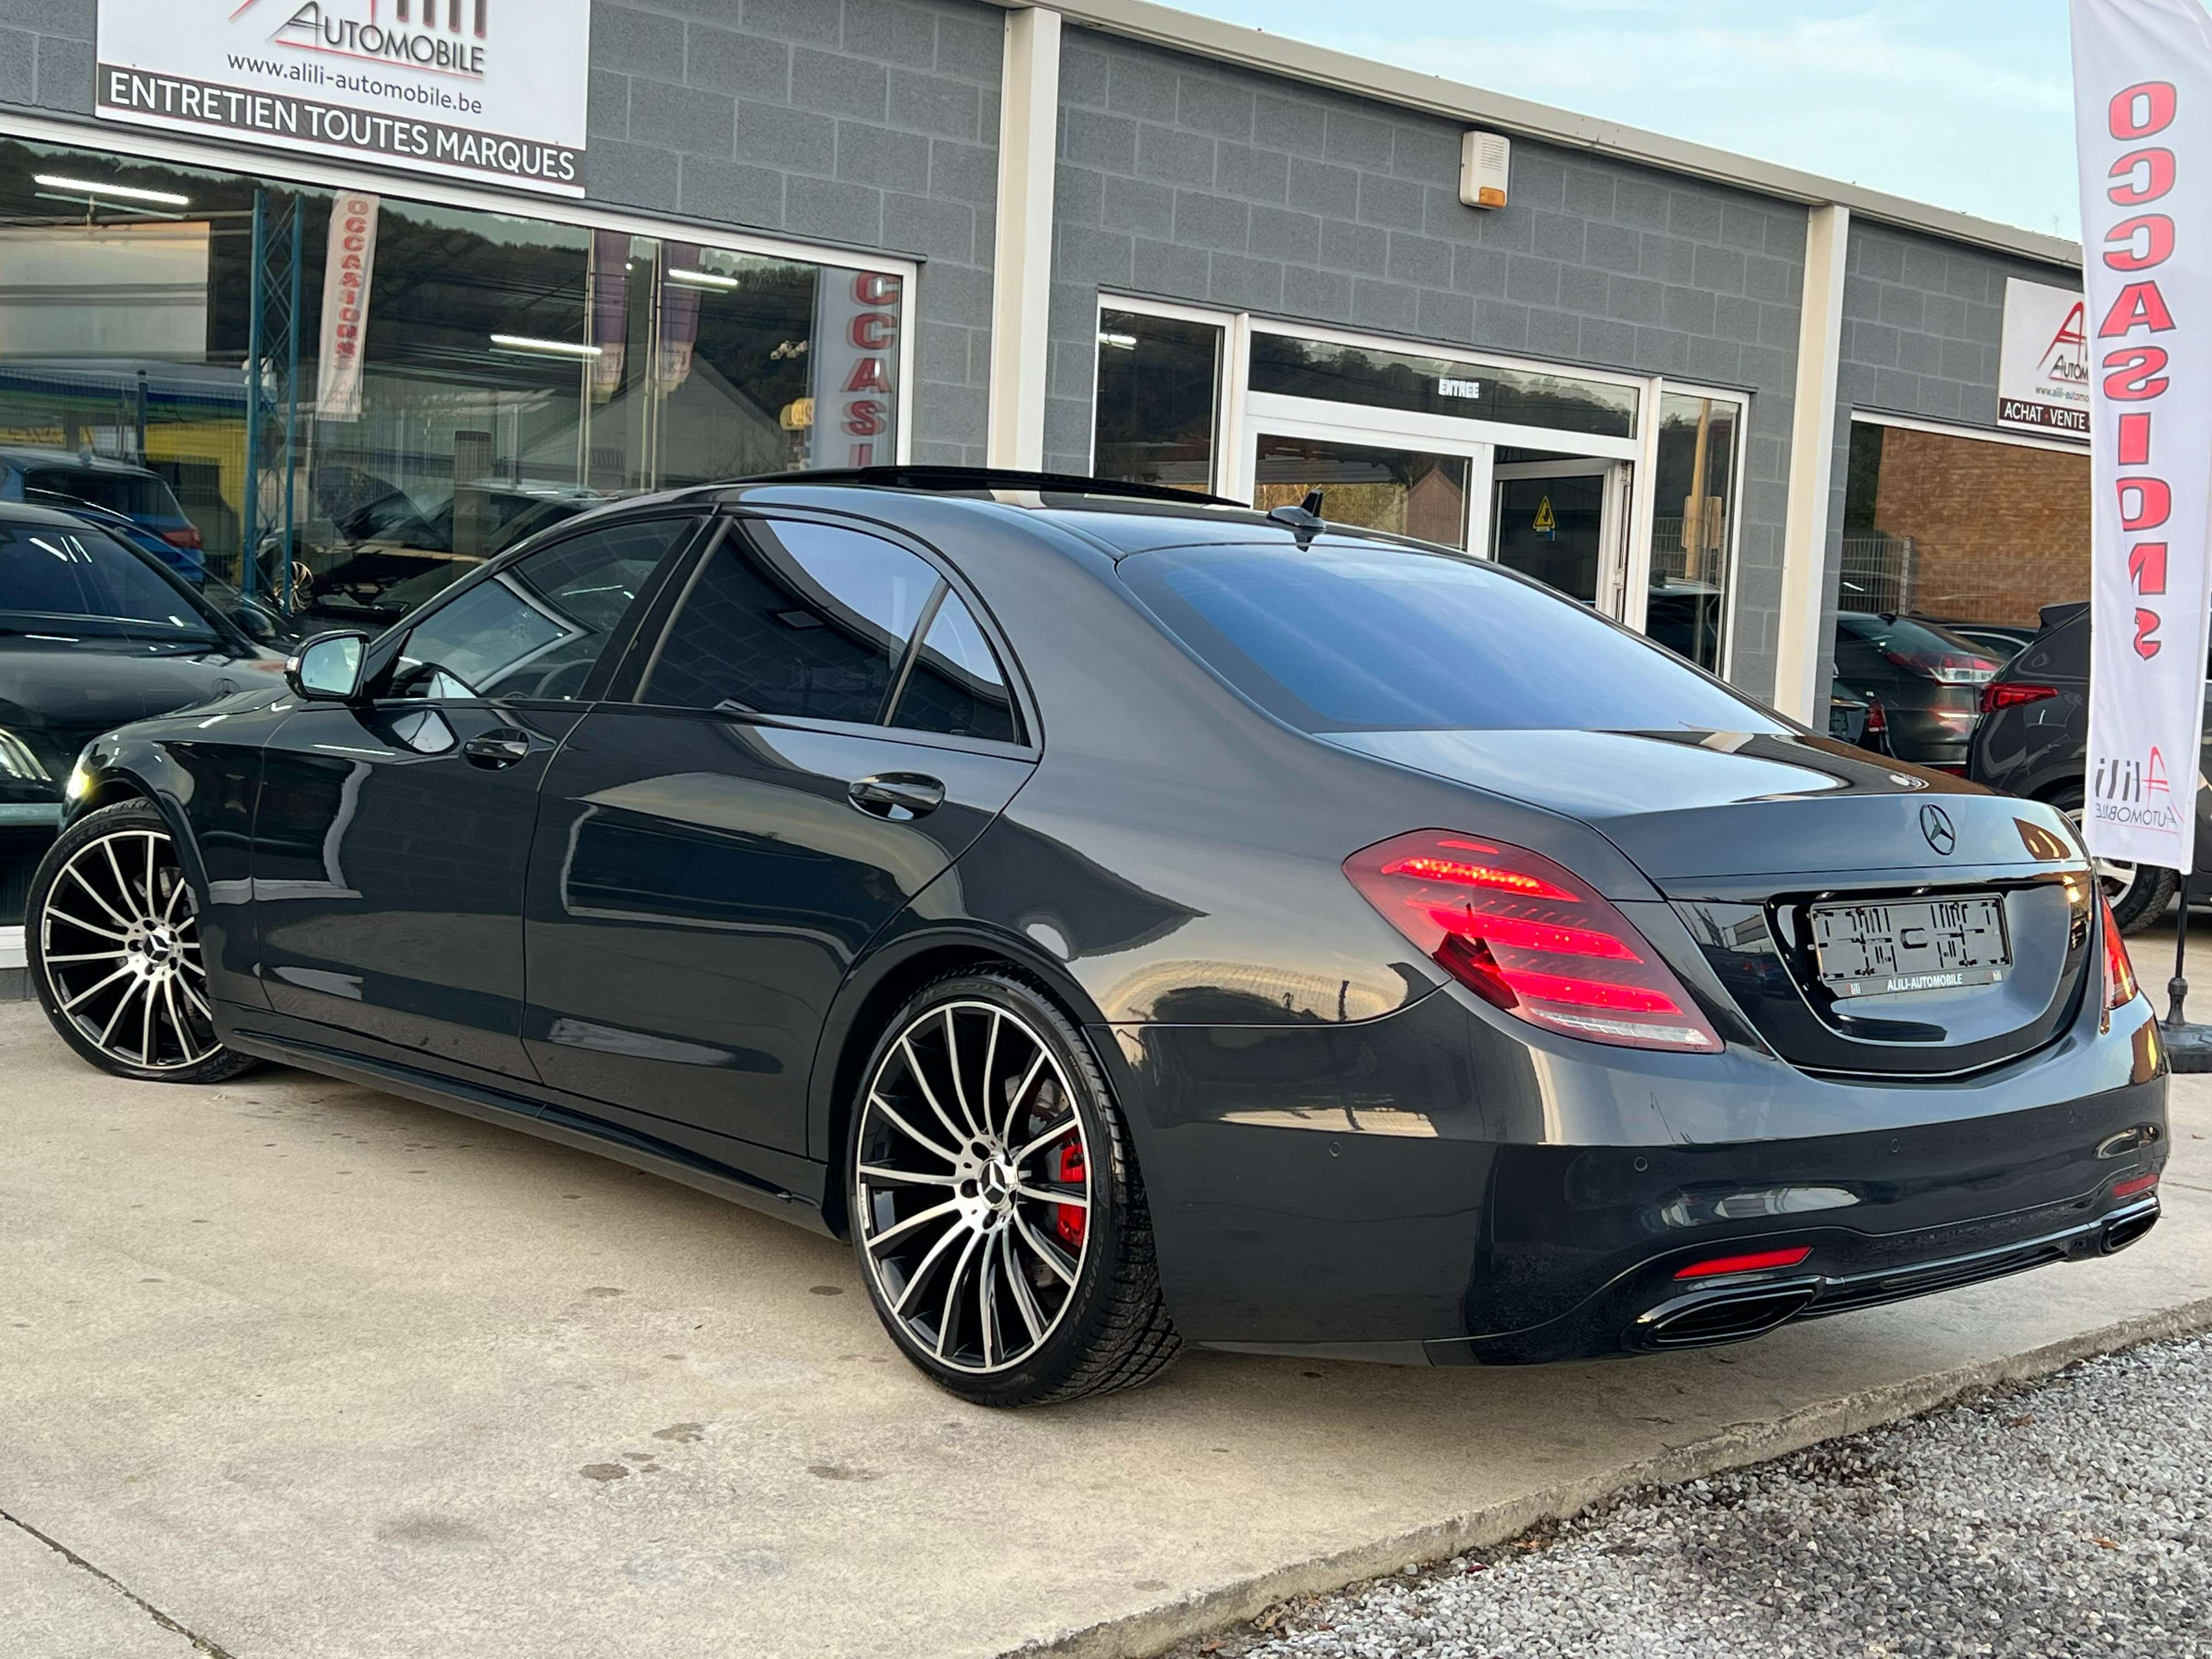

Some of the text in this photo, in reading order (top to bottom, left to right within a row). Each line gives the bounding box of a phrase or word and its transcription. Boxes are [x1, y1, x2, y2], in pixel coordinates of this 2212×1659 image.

[267, 0, 484, 74] AUTOMOBILE
[227, 54, 482, 114] www.alili-automobile.be
[110, 72, 575, 180] ENTRETIEN TOUTES MARQUES
[2049, 354, 2089, 380] AUTOM
[2004, 402, 2086, 430] ACHAT VENTE
[1887, 973, 1962, 991] ALILI-AUTOMOBILE
